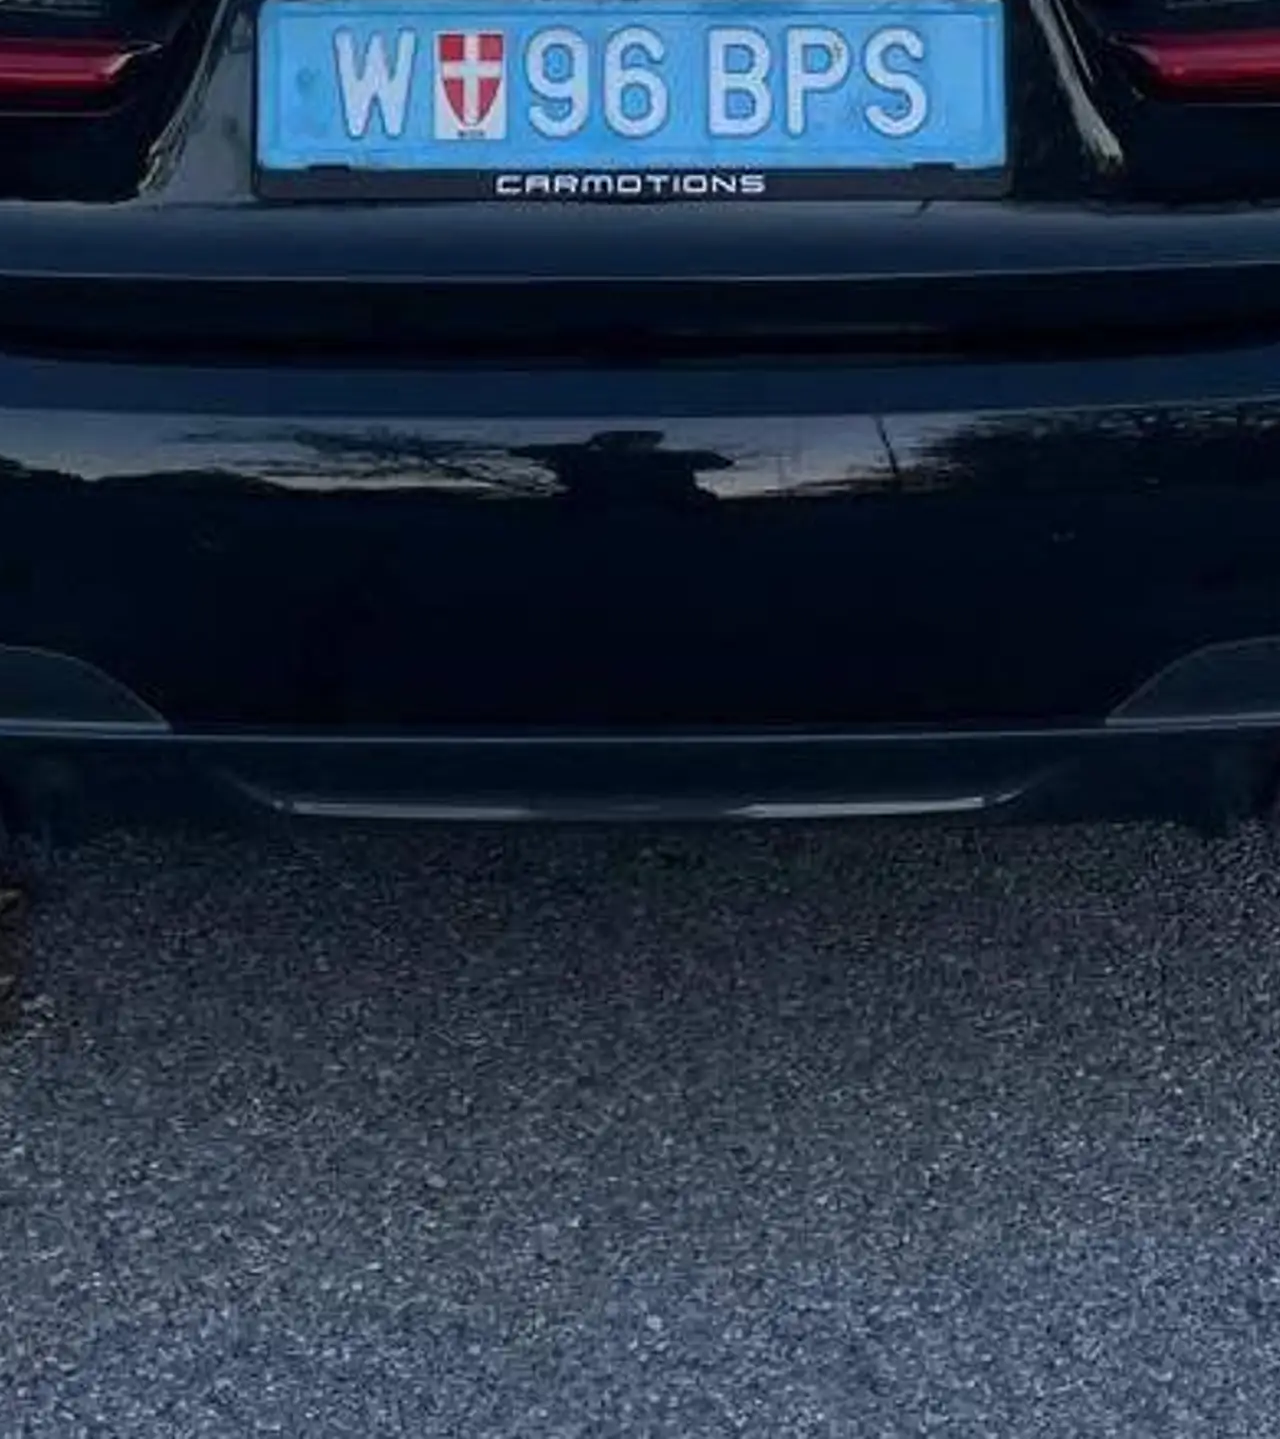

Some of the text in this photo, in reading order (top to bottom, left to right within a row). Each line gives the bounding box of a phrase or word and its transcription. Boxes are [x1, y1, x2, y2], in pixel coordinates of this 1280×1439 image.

[332, 24, 928, 139] W 96 BPS
[495, 173, 767, 196] CARMOTIONS
